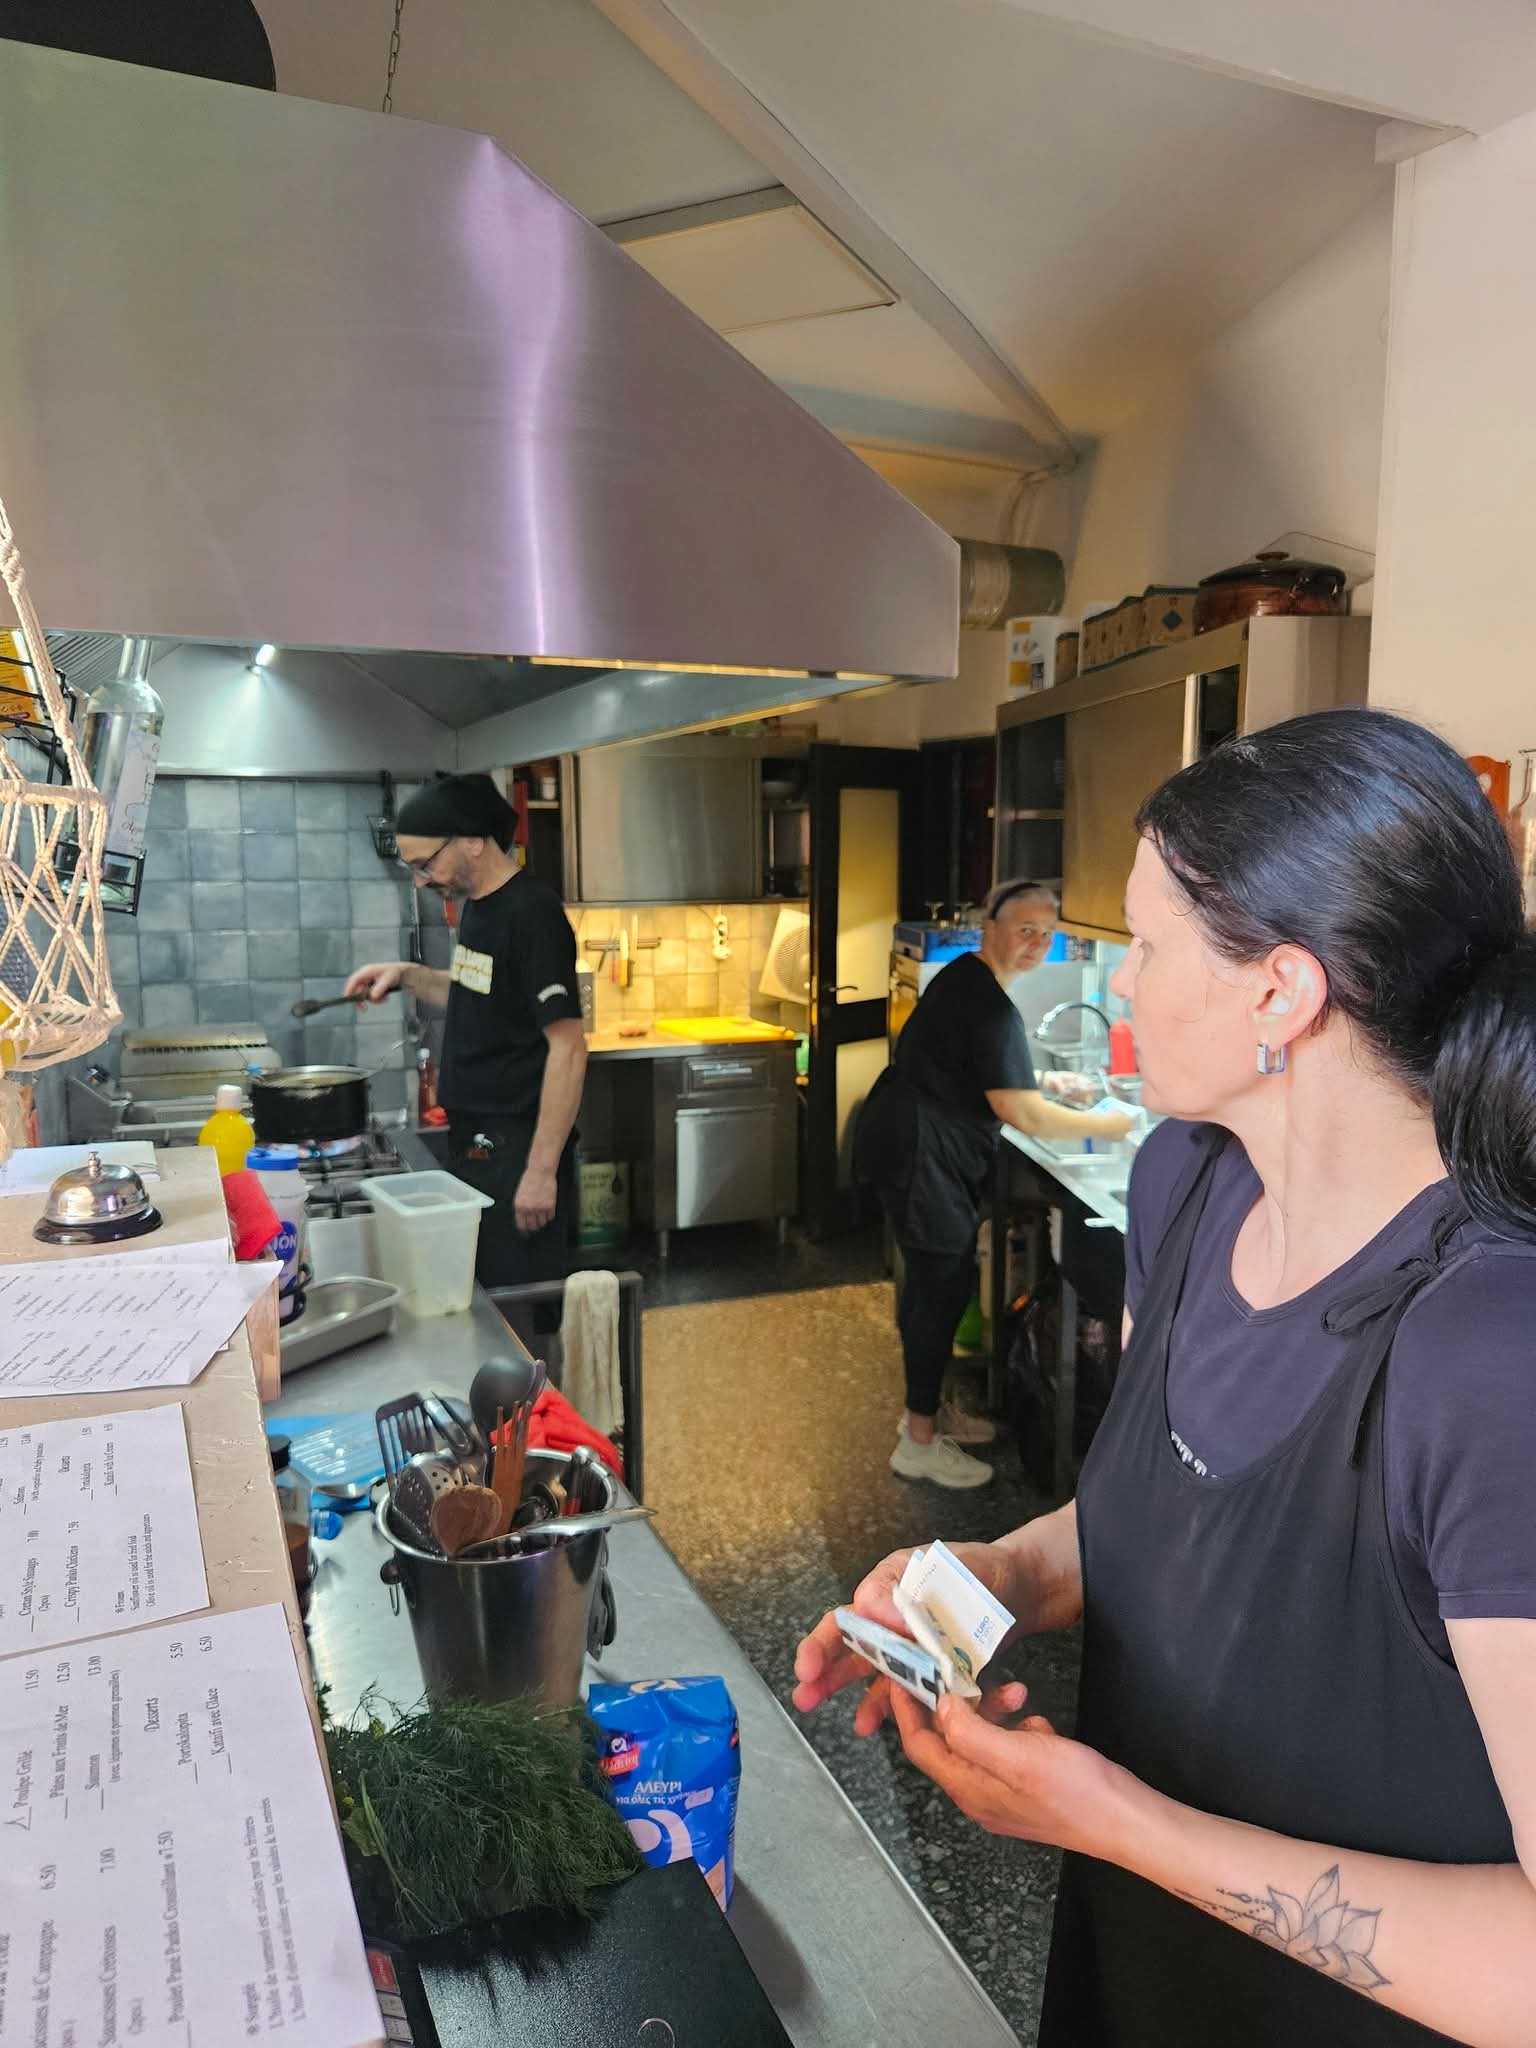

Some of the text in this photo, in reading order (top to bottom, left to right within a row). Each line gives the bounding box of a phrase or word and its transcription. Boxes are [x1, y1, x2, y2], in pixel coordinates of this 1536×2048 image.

[63, 1586, 80, 1608] Crispy
[973, 1615, 990, 1638] EURO
[169, 1642, 183, 1659] 5.50
[199, 1636, 213, 1652] 6.50
[57, 1662, 71, 1683] 12.50
[87, 1655, 101, 1676] 13.00
[25, 1669, 39, 1690] 11.50
[205, 1688, 221, 1710] Glace
[55, 1704, 69, 1722] Mer
[143, 1697, 160, 1732] Desserts
[208, 1709, 222, 1726] avec
[176, 1711, 192, 1766] Portokalopita
[11, 1775, 34, 1808] Poulpe
[634, 1781, 683, 1794] ΑΛΕΥΡΙ
[40, 1864, 56, 1890] 6.50
